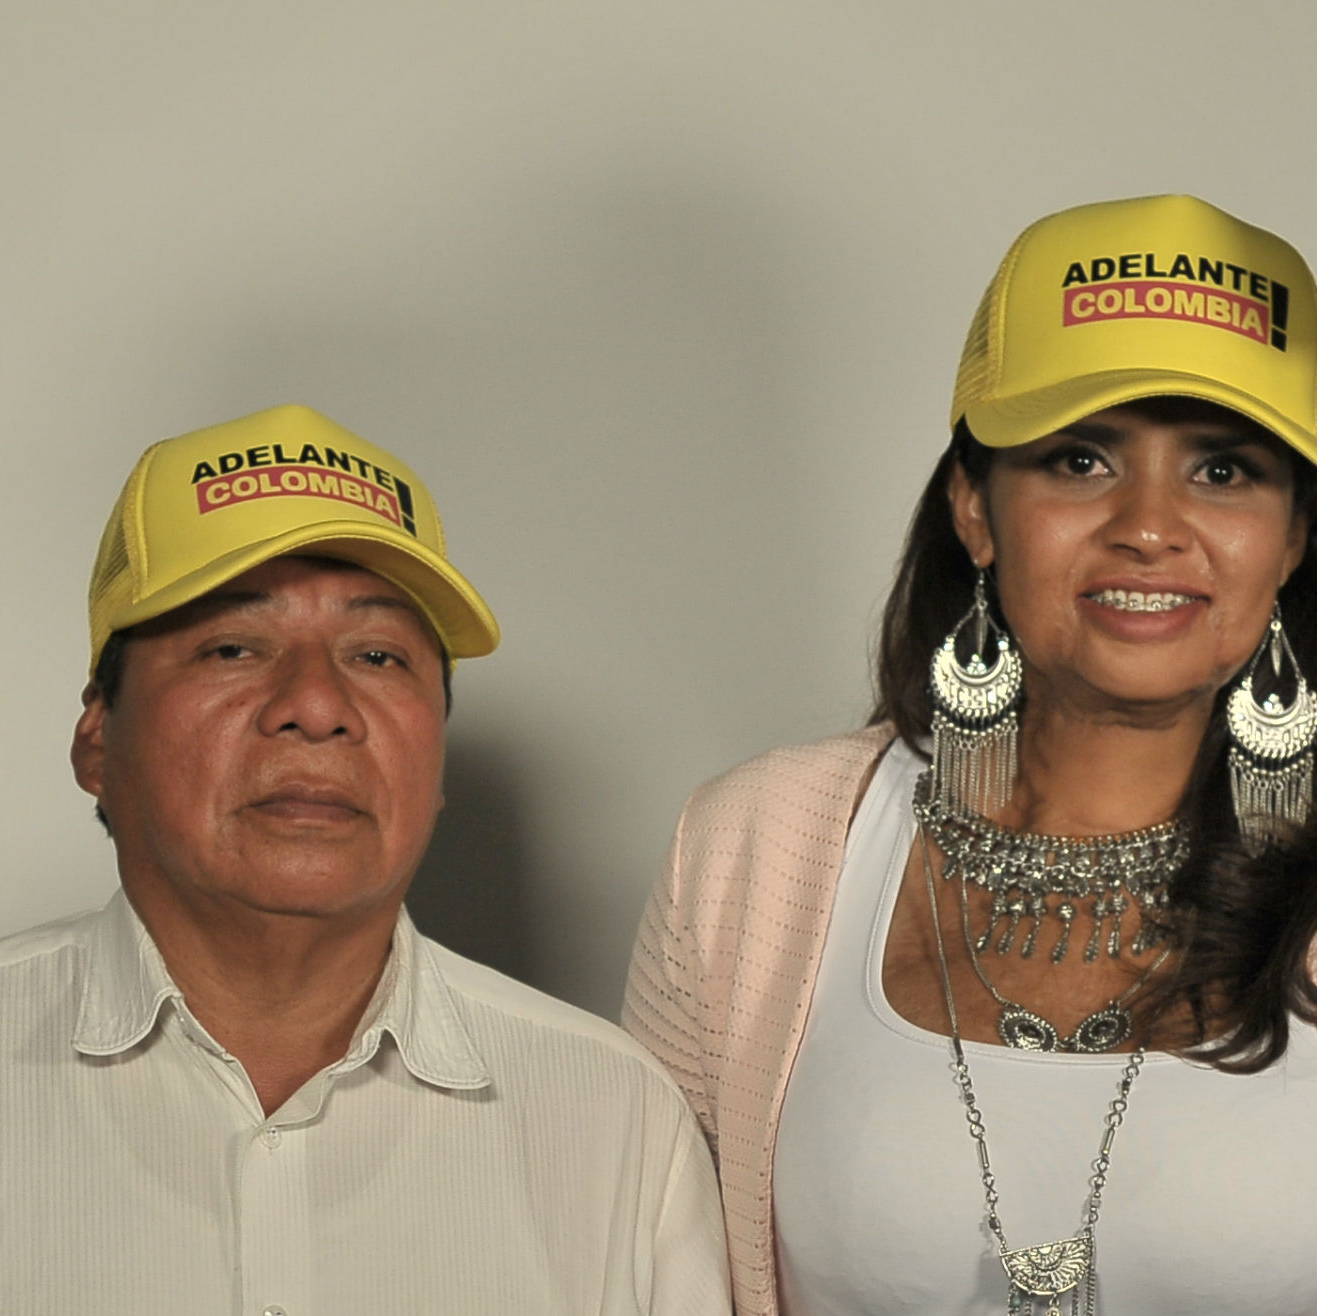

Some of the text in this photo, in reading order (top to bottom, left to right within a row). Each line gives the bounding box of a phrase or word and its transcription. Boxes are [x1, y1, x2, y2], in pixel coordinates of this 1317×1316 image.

[1062, 253, 1269, 303] ADELANTE
[1071, 287, 1265, 337] COLOMBIA
[191, 443, 395, 485] ADELANTE
[205, 470, 397, 520] COLOMBIA
